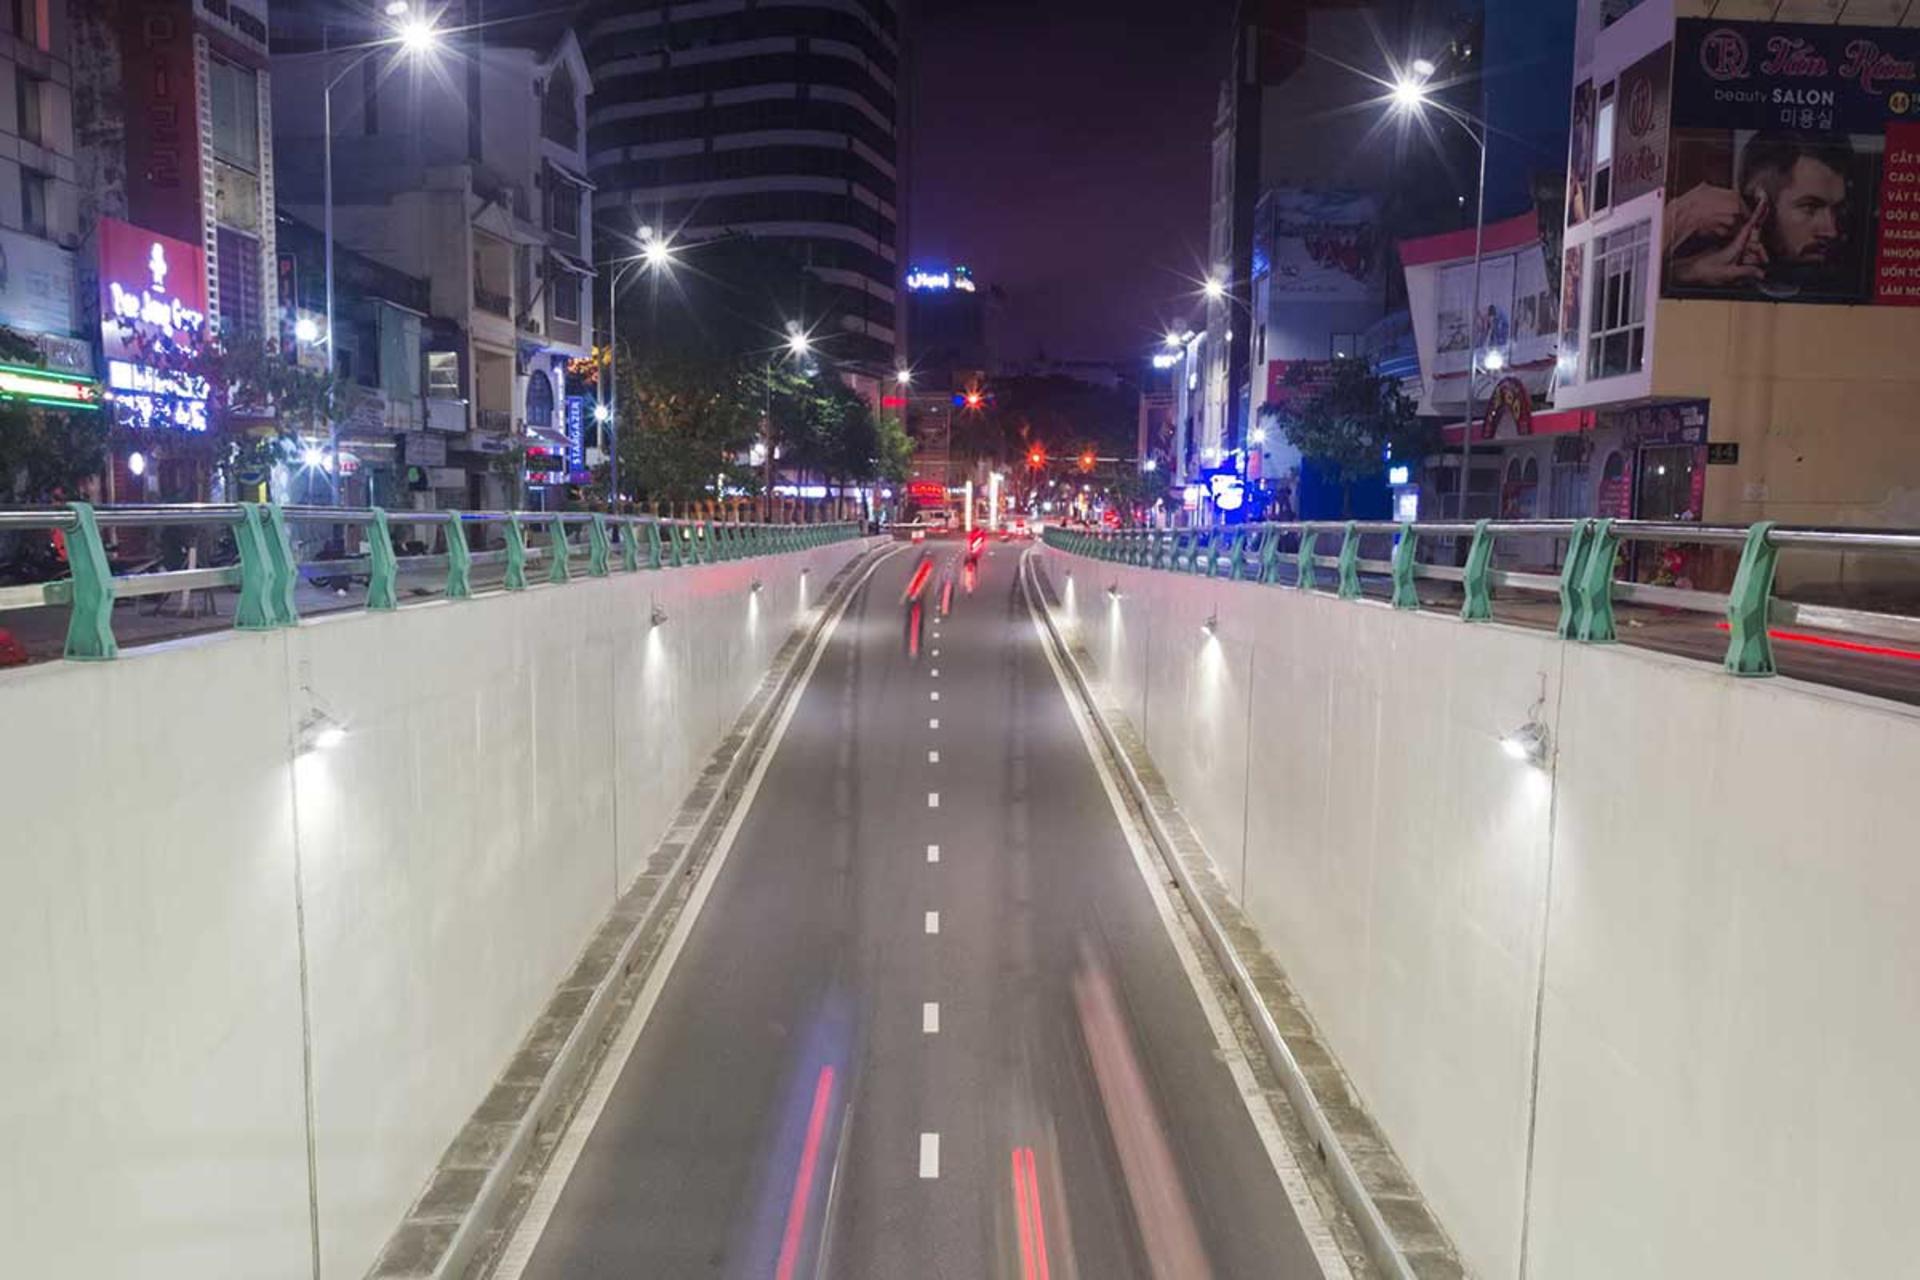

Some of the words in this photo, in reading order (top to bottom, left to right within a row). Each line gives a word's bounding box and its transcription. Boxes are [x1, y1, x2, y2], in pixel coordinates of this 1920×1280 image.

[1714, 88, 1768, 104] beauty
[1772, 88, 1835, 105] SALON
[1780, 108, 1833, 130] 미용실
[571, 400, 582, 466] STARGAZER
